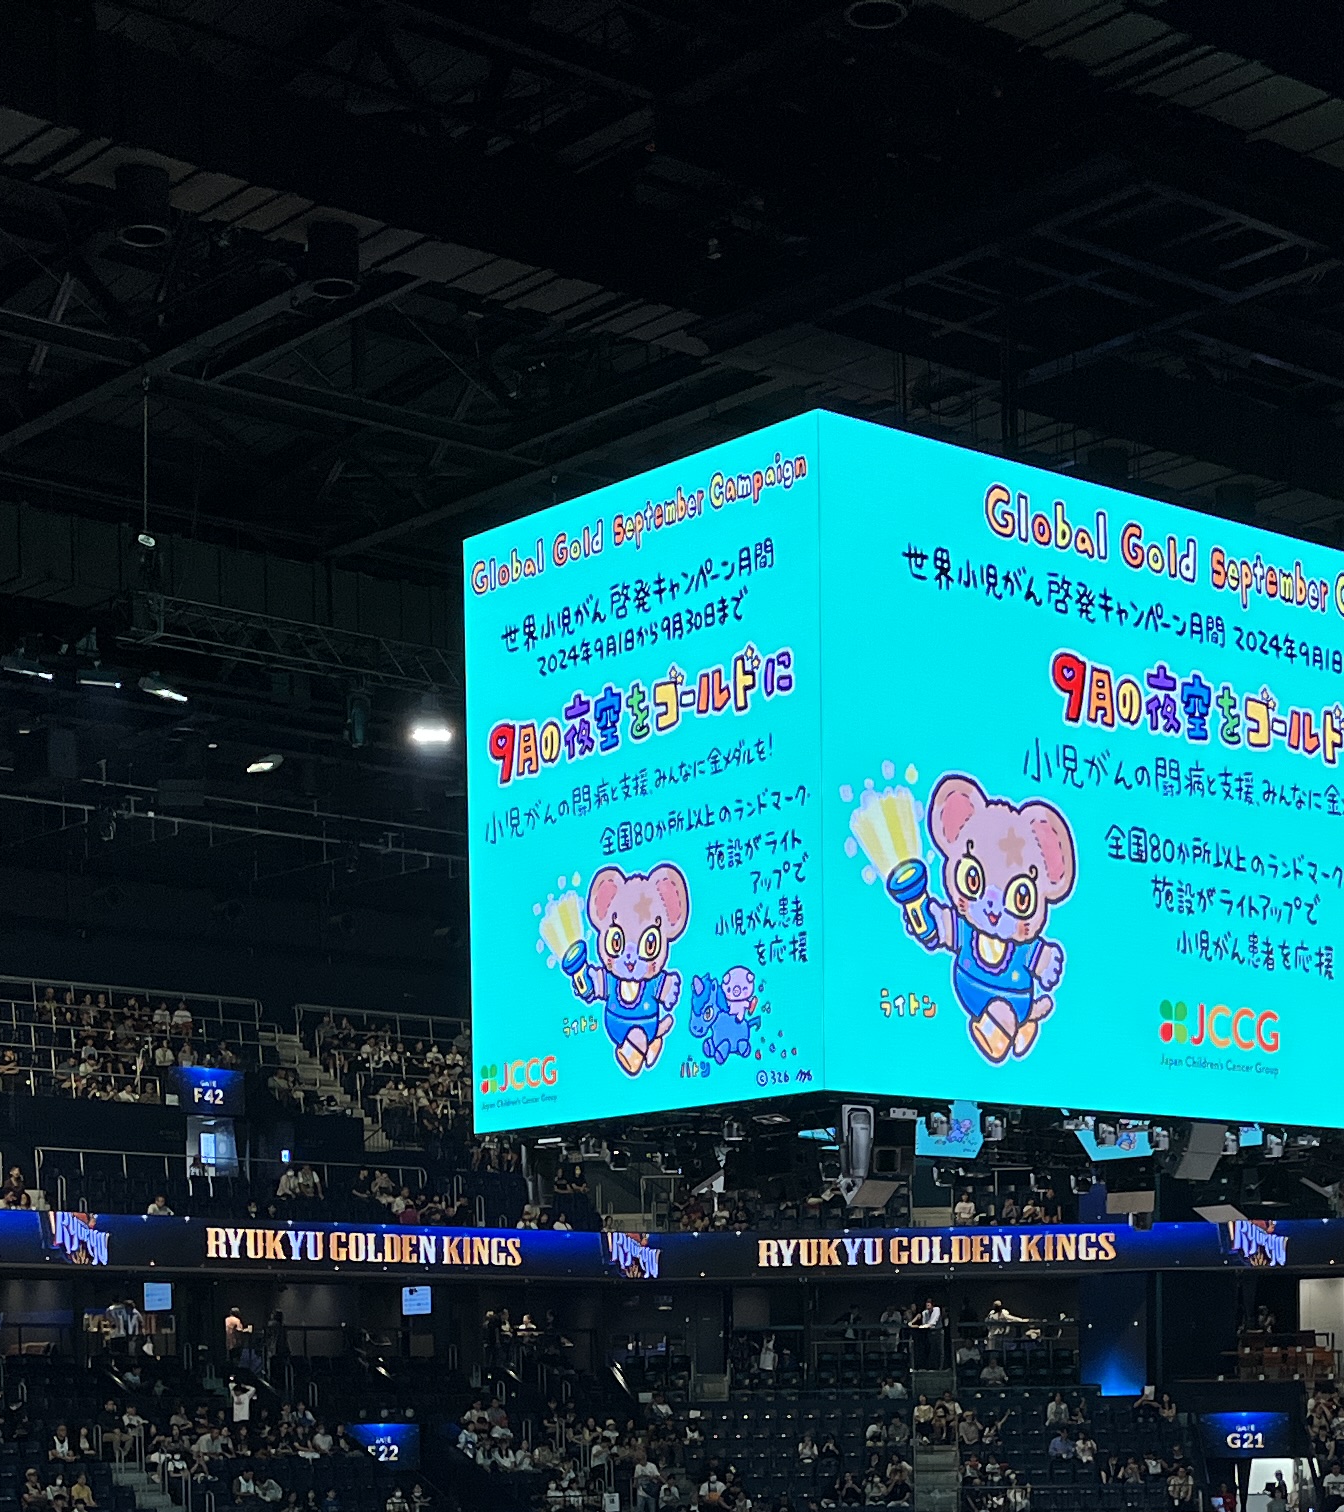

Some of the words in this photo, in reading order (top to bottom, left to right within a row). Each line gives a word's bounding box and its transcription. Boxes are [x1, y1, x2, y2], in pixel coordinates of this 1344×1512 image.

[471, 537, 545, 595] Global
[552, 519, 604, 568] Gold
[613, 486, 704, 549] September
[709, 452, 807, 509] Campaign
[984, 484, 1108, 560] Global
[1121, 522, 1198, 584] Gold
[1211, 547, 1329, 609] September
[489, 645, 794, 784] 9月の夜空をゴールドに
[705, 828, 802, 871] 施設がライト
[751, 852, 809, 894] アップで
[715, 895, 805, 937] 小児がん患者
[1151, 875, 1321, 926] 施設がライトアップで
[754, 930, 809, 966] を応援
[1176, 929, 1335, 980] 小児がん患者を応援
[879, 987, 937, 1018] ライトン
[1190, 1004, 1280, 1053] JCCG
[498, 1055, 558, 1092] JCCG
[1159, 1054, 1184, 1069] Japan
[206, 1227, 324, 1261] RYUKYU
[328, 1232, 437, 1264] GOLDEN
[442, 1236, 522, 1267] KINGS
[758, 1238, 884, 1267] RYUKYU
[889, 1235, 1013, 1265] GOLDEN
[1019, 1232, 1117, 1262] KINGS
[1226, 1432, 1264, 1449] G21
